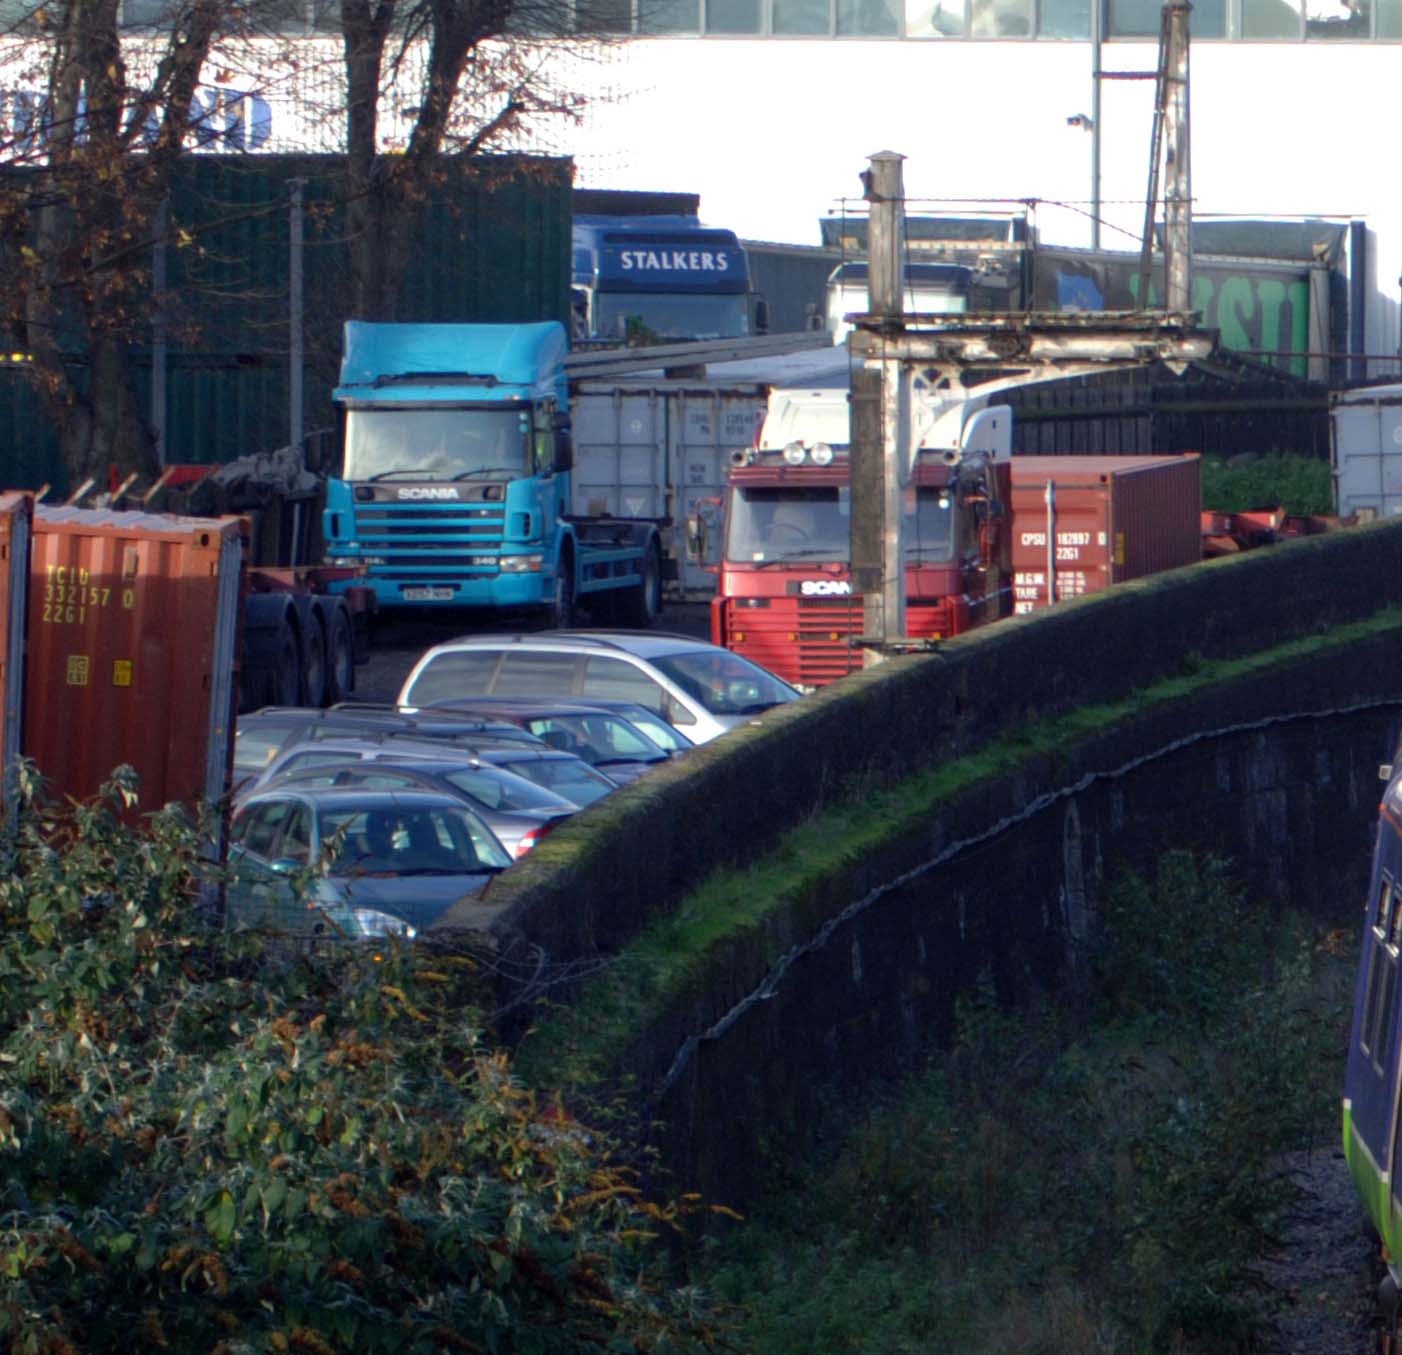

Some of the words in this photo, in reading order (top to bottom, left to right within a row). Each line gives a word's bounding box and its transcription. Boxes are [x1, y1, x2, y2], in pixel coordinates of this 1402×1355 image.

[620, 251, 729, 271] STALKERS
[397, 487, 460, 500] SCANIA
[1021, 532, 1047, 546] CPSU
[1056, 546, 1080, 560] 22G1
[801, 581, 853, 595] SCAN
[45, 584, 112, 608] 332157
[42, 603, 86, 625] 22G1
[1014, 601, 1034, 614] NET
